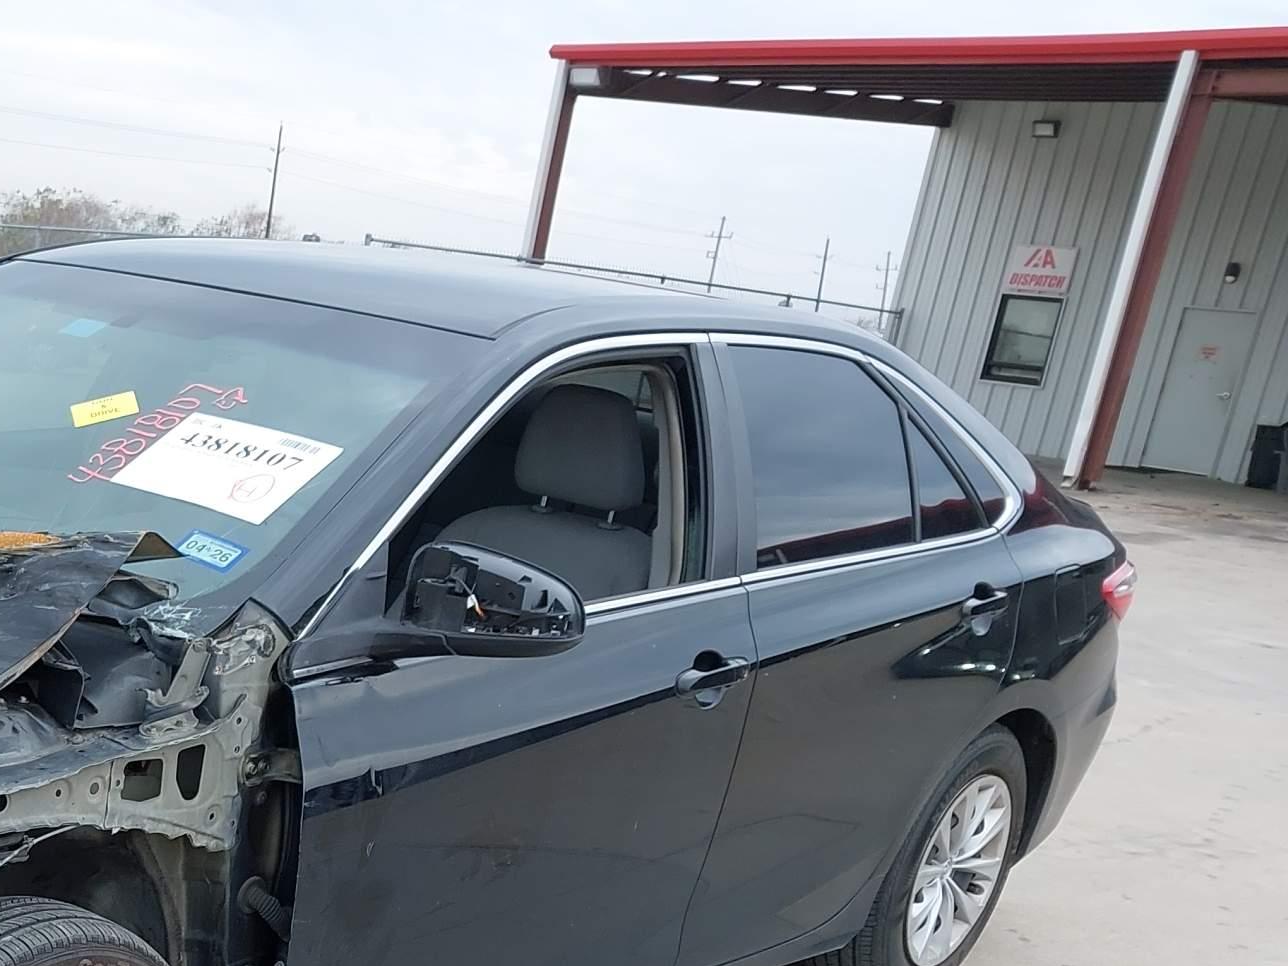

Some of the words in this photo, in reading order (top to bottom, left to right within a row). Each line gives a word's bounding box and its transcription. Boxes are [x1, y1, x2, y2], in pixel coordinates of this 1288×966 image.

[1009, 273, 1066, 288] DISPATCH
[180, 433, 304, 470] 43818107
[186, 540, 208, 553] 04
[212, 549, 232, 563] 26
